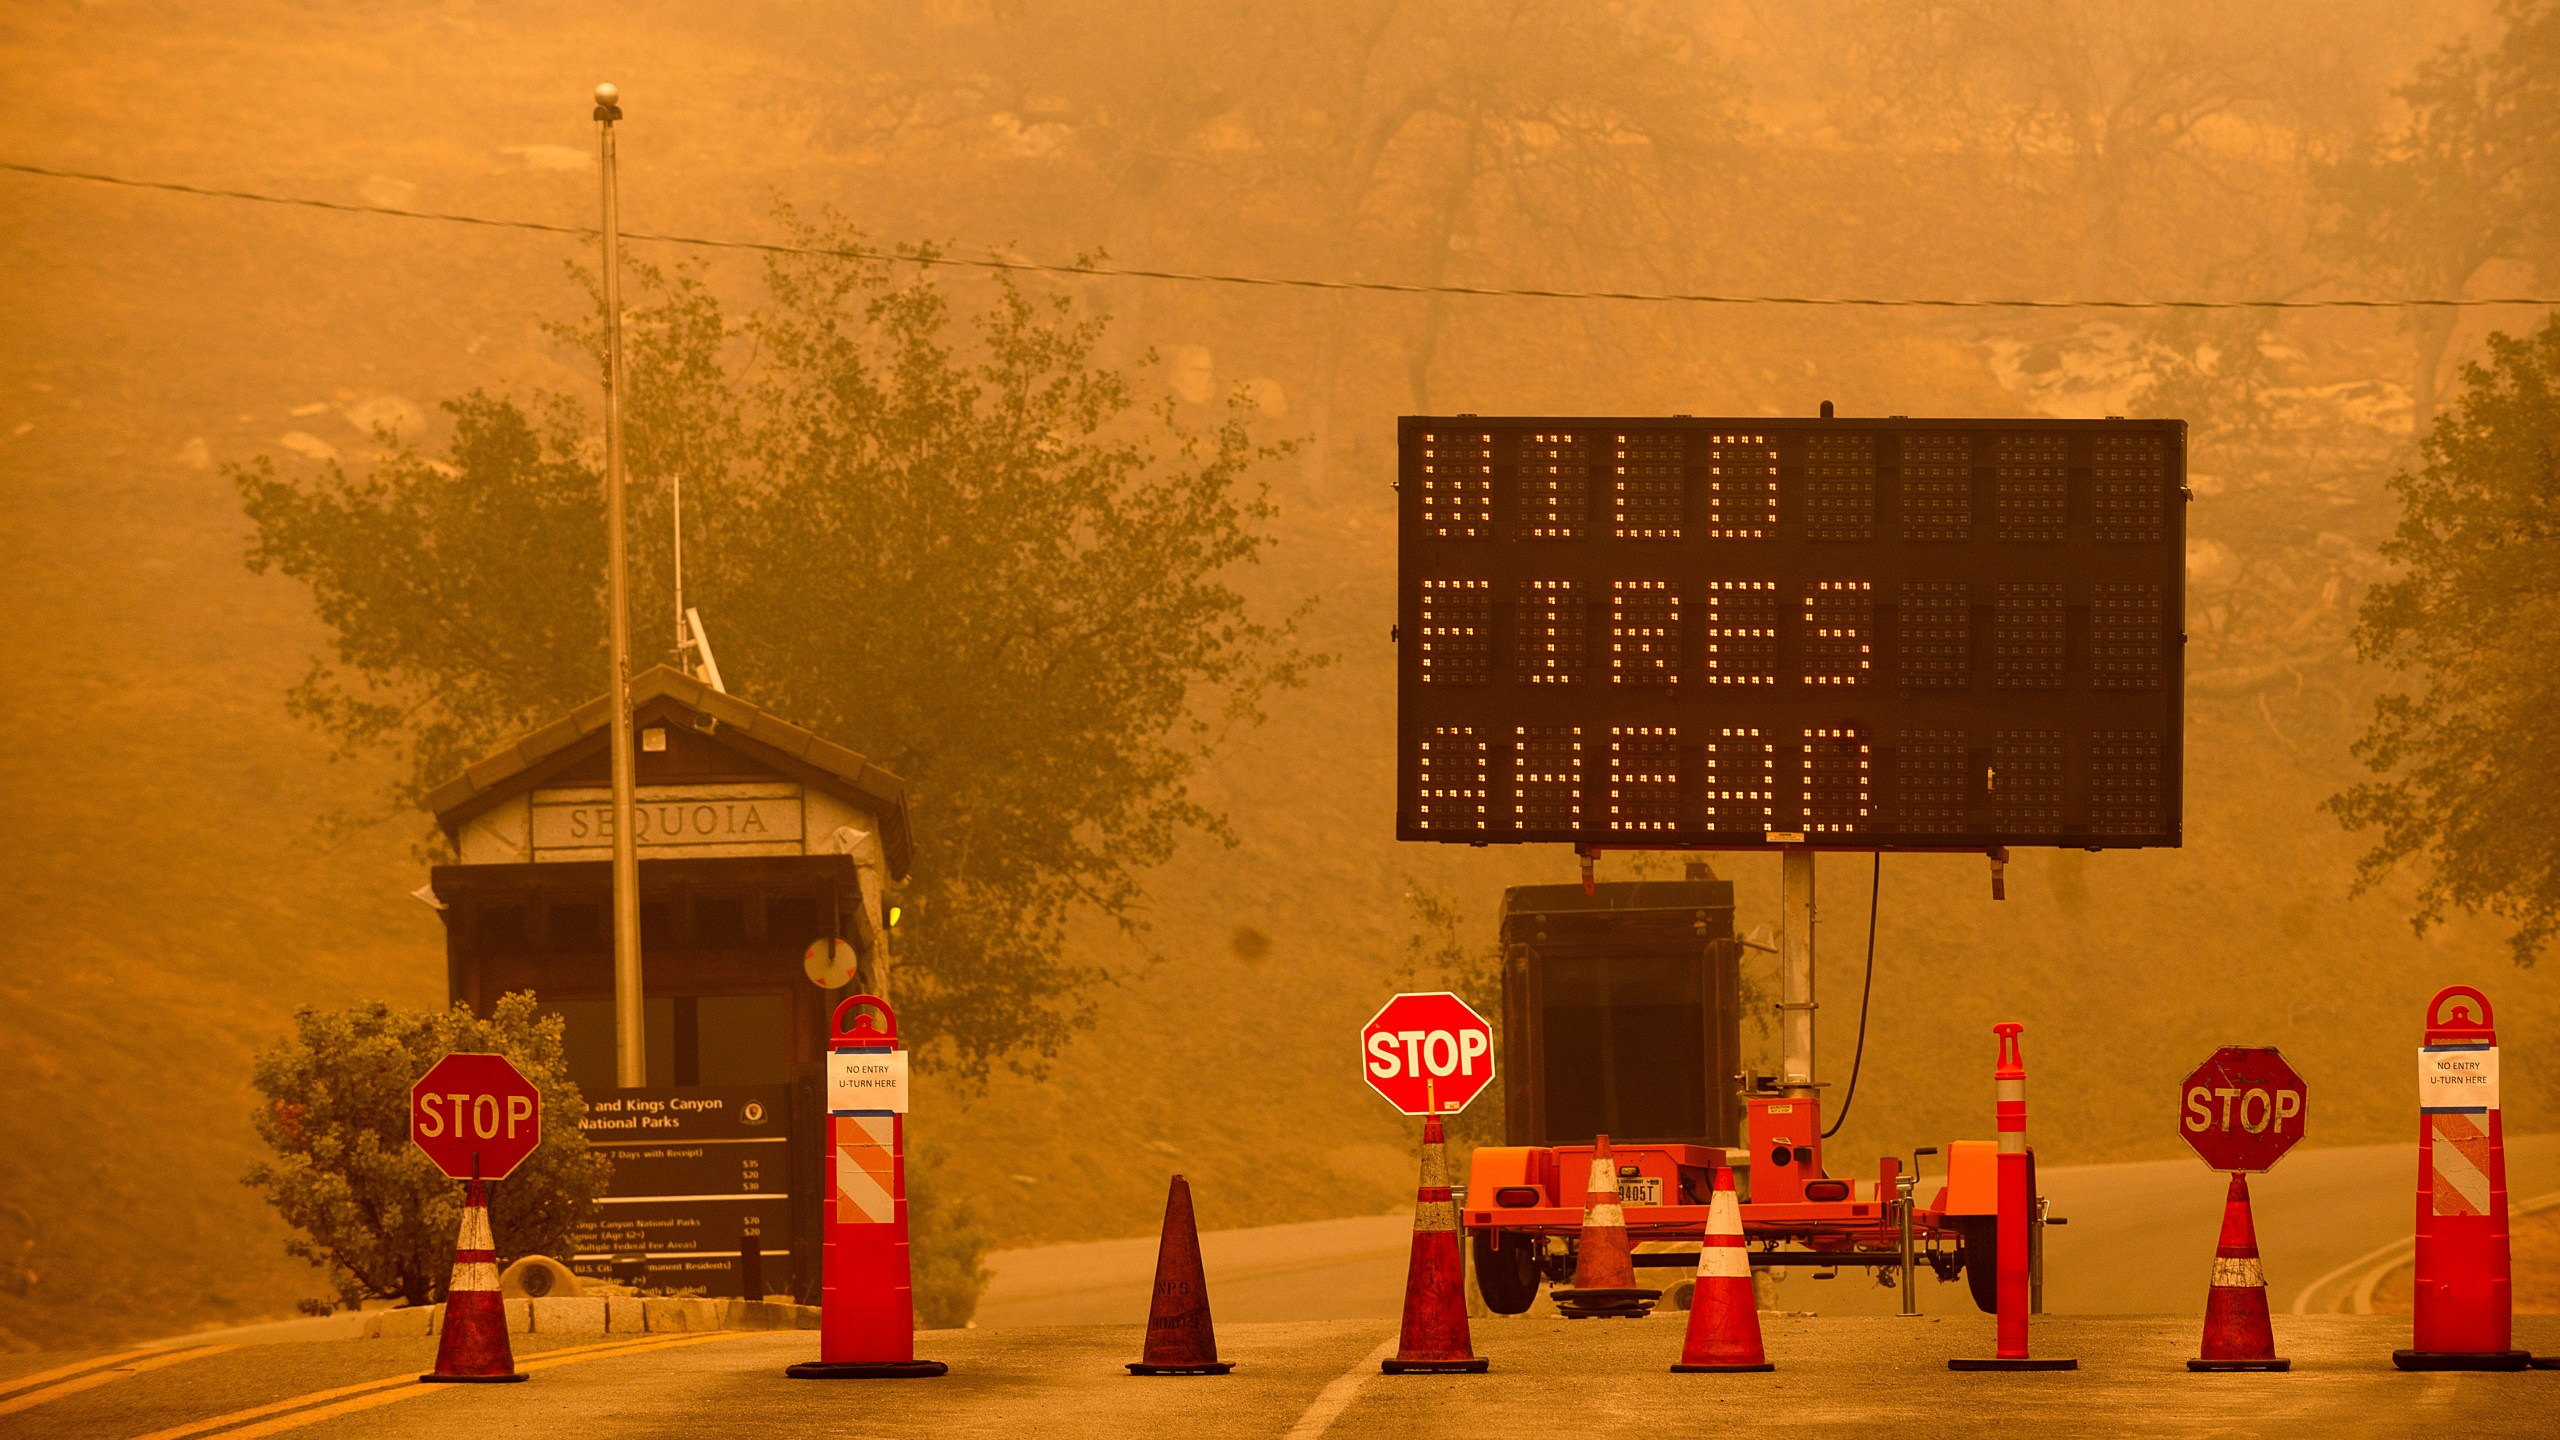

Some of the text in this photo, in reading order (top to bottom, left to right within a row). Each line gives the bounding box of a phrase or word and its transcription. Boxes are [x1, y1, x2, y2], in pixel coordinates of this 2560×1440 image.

[1424, 433, 1779, 538] WILD
[1421, 580, 1872, 686] FIRES
[1420, 726, 1870, 832] AHEAD
[1368, 1029, 1487, 1078] STOP
[846, 1065, 889, 1074] NO ENTRY
[2437, 1062, 2480, 1070] NO ENTRY
[839, 1079, 897, 1088] U-TURN HERE
[2430, 1076, 2487, 1084] U-TURN HERE
[595, 1099, 621, 1112] and
[626, 1098, 665, 1113] Kings
[670, 1097, 723, 1113] Canyon
[2185, 1086, 2300, 1134] STOP
[419, 1092, 533, 1139] STOP
[578, 1115, 680, 1130] National Parks
[619, 1150, 640, 1160] Days
[644, 1148, 665, 1158] with
[1618, 1186, 1654, 1201] 9405T
[576, 1217, 701, 1231] ings Canyon National Parks
